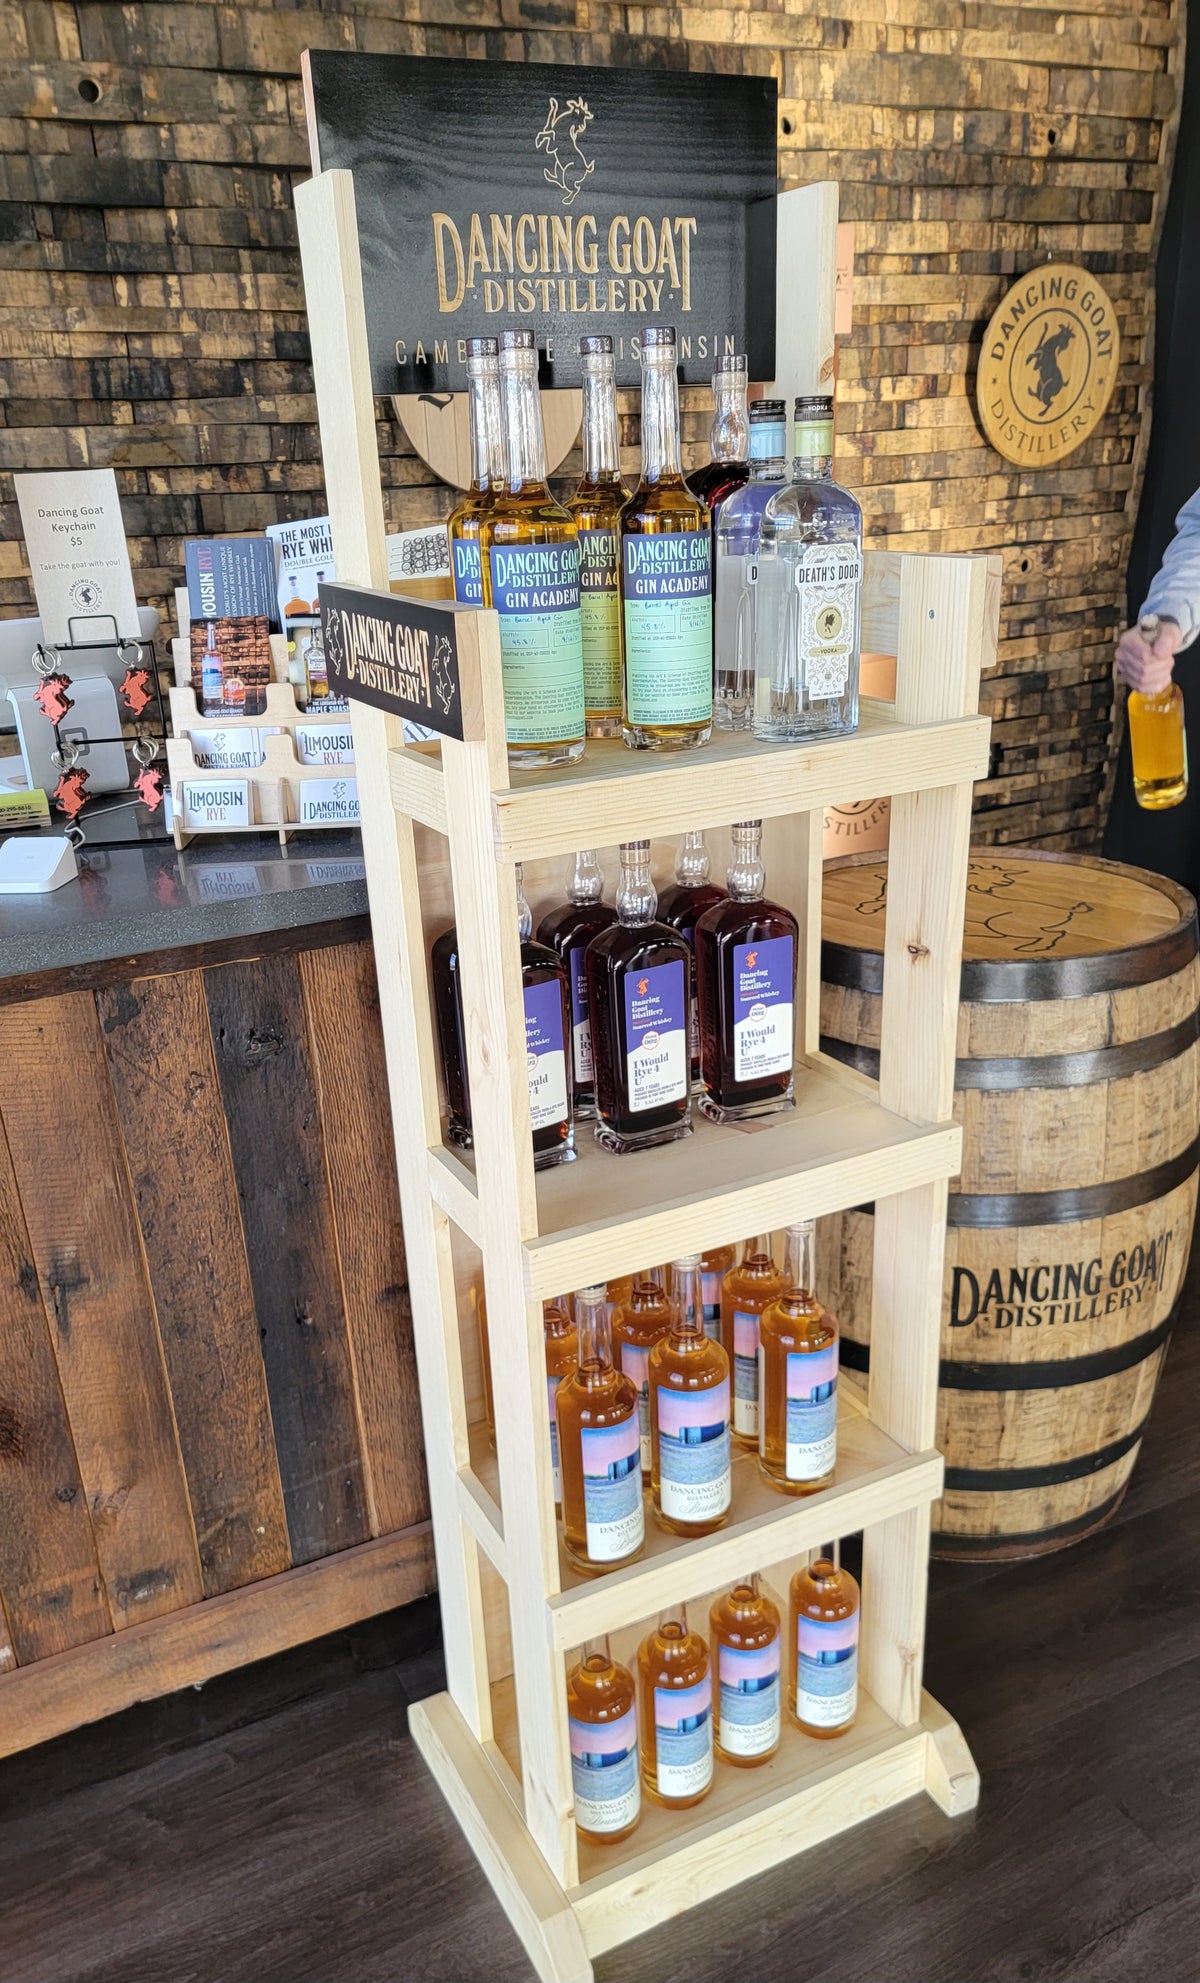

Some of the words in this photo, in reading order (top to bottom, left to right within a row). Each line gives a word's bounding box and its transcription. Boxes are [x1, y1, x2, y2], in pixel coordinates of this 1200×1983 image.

[432, 212, 599, 312] DANCING
[608, 215, 697, 311] GOAT
[484, 279, 664, 312] DISTILLERY
[991, 276, 1078, 361] DANCING
[1080, 291, 1114, 360] GOAT
[395, 338, 555, 365] CAMBE
[619, 335, 735, 360] ISNSIN
[991, 396, 1096, 453] DISTILLERY
[38, 507, 78, 518] Dancing
[80, 506, 105, 516] Goat
[51, 521, 96, 533] Keychain
[279, 530, 297, 544] THE
[299, 525, 325, 540] MOST
[70, 536, 83, 547] $5
[196, 547, 213, 570] RYE
[219, 545, 227, 571] UNIQUE
[282, 542, 307, 560] RYE
[628, 539, 688, 575] DANCING
[40, 563, 57, 571] Take
[71, 561, 87, 570] goat
[284, 557, 313, 568] DOUBLE
[495, 551, 558, 588] DANCING
[642, 559, 706, 575] DISTILLERY
[513, 571, 576, 588] DISTILLERY
[581, 572, 602, 587] GIN
[799, 566, 836, 584] DEATH'S
[838, 563, 859, 581] DOOR
[69, 579, 89, 597] DANCING
[89, 580, 103, 594] GOAT
[230, 585, 236, 594] OF
[635, 579, 657, 594] GIN
[660, 575, 709, 593] ACADEMY
[506, 592, 529, 608] GIN
[532, 587, 579, 607] ACADEMY
[340, 610, 396, 680] DANCING
[395, 624, 432, 708] GOAT
[358, 659, 421, 704] DISTILLERY
[305, 705, 327, 714] MAPLE
[195, 751, 228, 767] DANCING
[230, 750, 251, 768] GOAT
[323, 751, 344, 764] RYE
[186, 787, 245, 812] LIMOUSIN
[206, 808, 226, 821] RYE
[310, 801, 347, 819] DANCING
[739, 977, 756, 985] Goat
[740, 969, 768, 980] Dancing
[740, 981, 771, 992] Distillery
[631, 996, 660, 1007] Dancing
[631, 1003, 648, 1013] Goat
[632, 1008, 664, 1020] Distillery
[740, 1031, 745, 1039] I
[746, 1024, 776, 1039] Would
[740, 1038, 759, 1049] Rye
[760, 1036, 766, 1044] 4
[580, 1049, 587, 1058] U
[633, 1061, 638, 1069] I
[640, 1052, 669, 1066] Would
[740, 1048, 748, 1057] U
[634, 1067, 653, 1078] Rye
[653, 1064, 660, 1073] 4
[528, 1073, 549, 1089] ould
[634, 1078, 642, 1086] U
[533, 1086, 540, 1095] 4
[948, 1257, 1103, 1328] DANCING
[1109, 1230, 1173, 1294] GOAT
[994, 1280, 1148, 1329] DISTILLERY
[670, 1484, 714, 1495] DANCING
